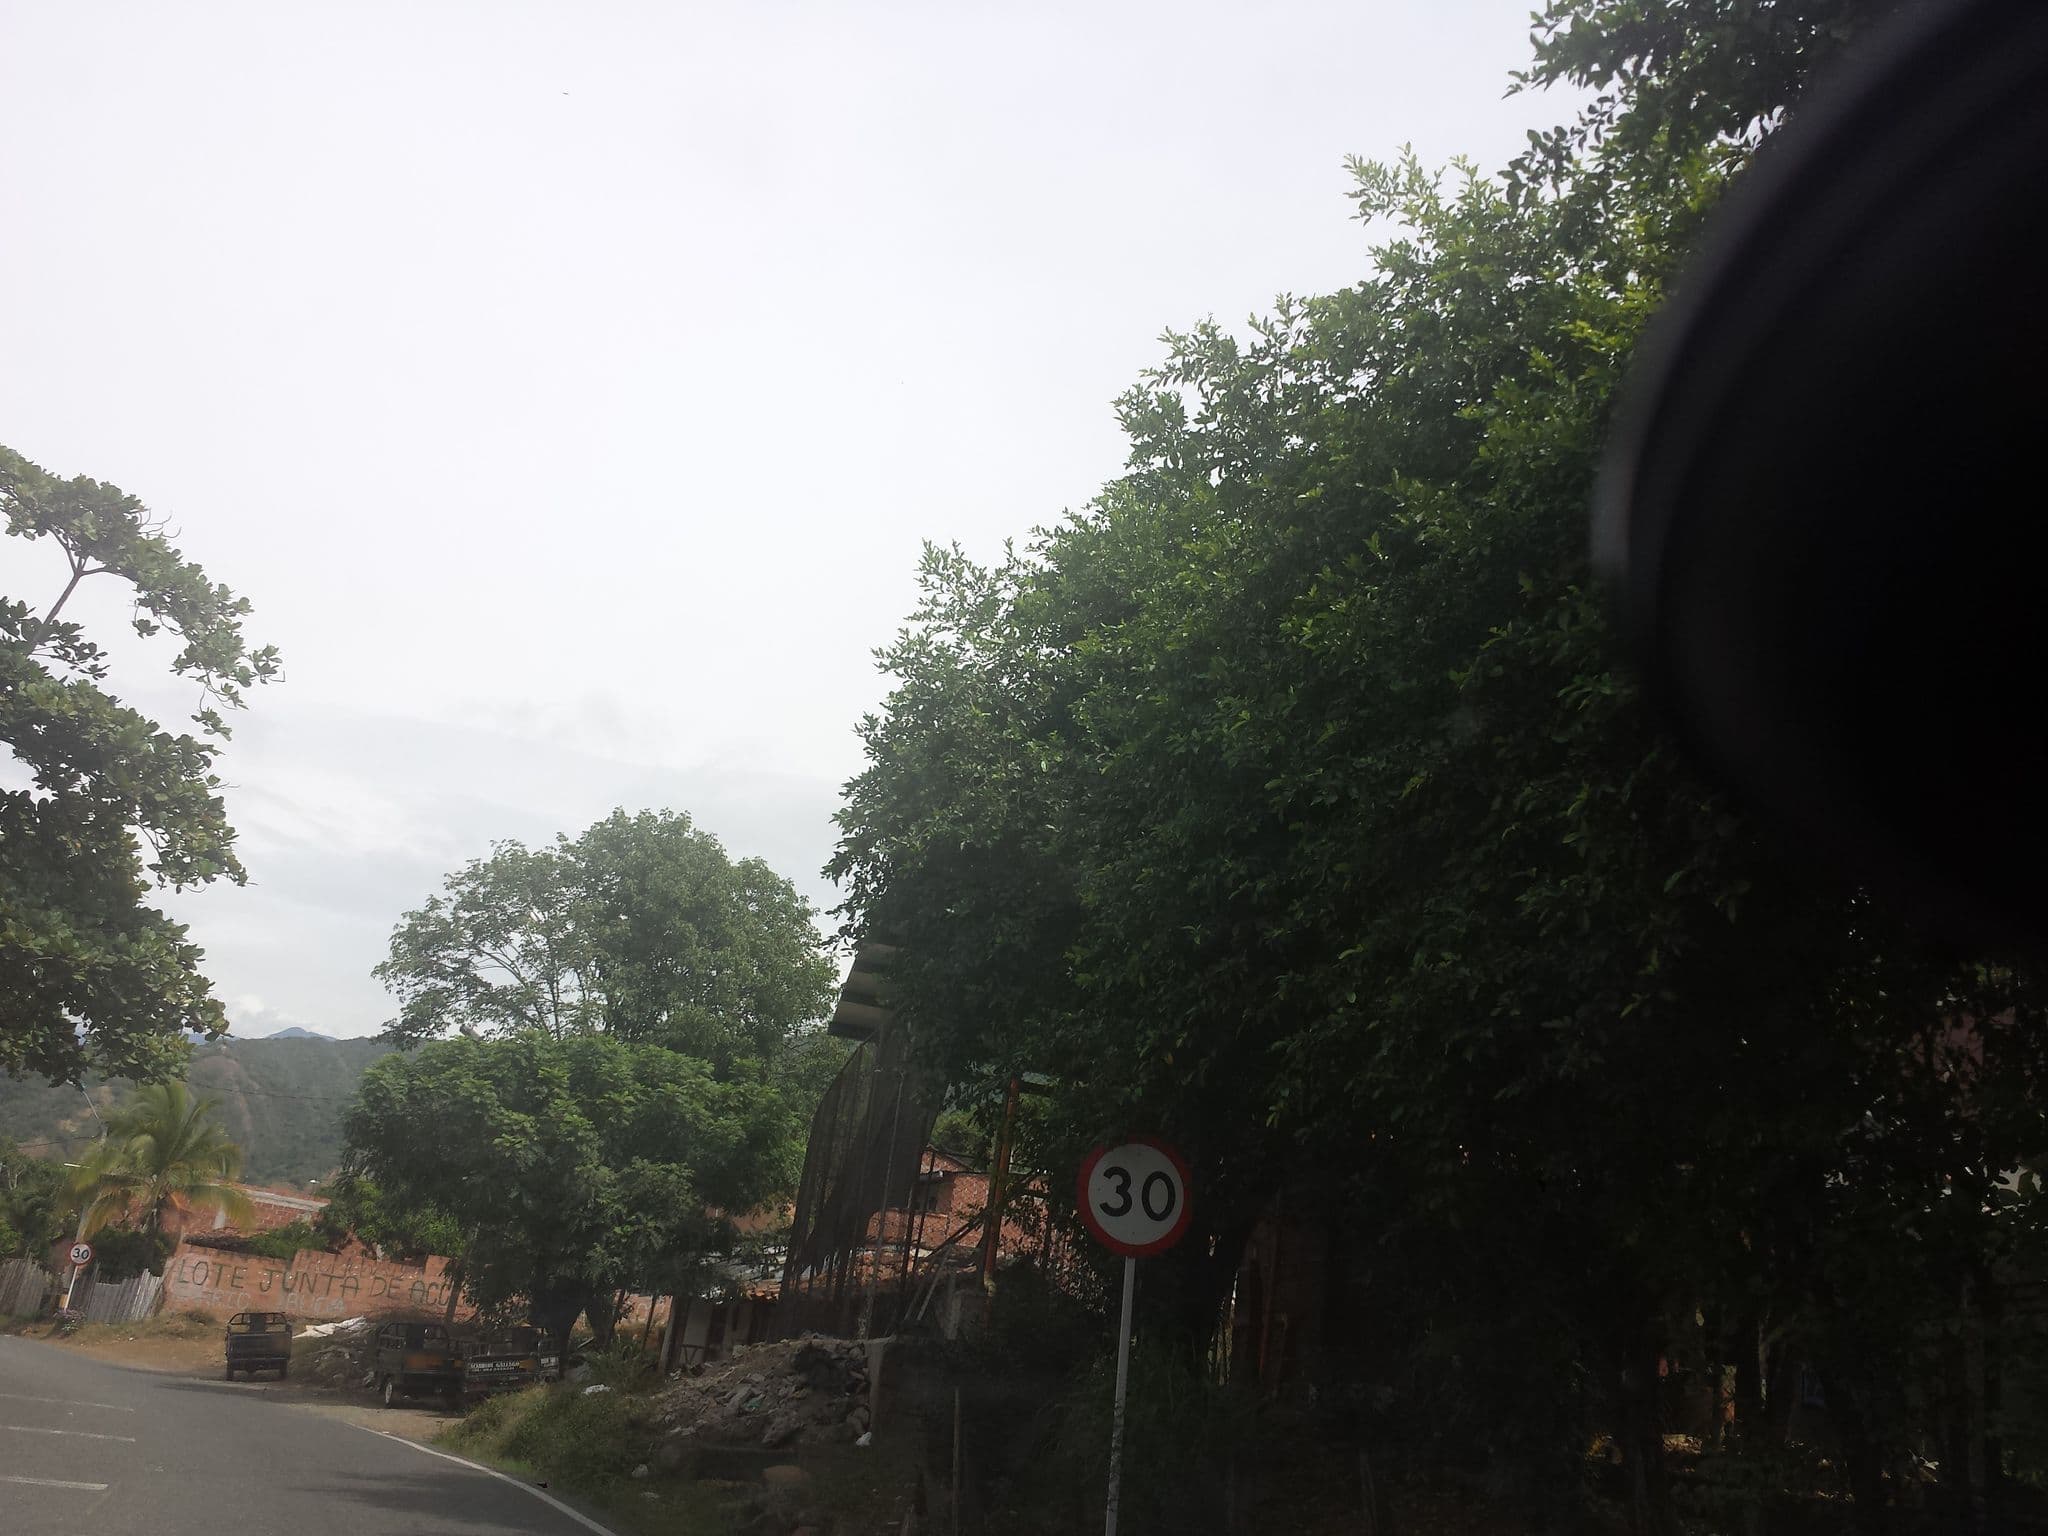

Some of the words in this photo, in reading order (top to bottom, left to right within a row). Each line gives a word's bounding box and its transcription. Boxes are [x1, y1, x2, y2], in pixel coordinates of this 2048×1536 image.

[1100, 1166, 1176, 1221] 30
[72, 1247, 90, 1260] 30
[177, 1258, 248, 1289] LOTE
[259, 1267, 360, 1299] JUNTA
[369, 1275, 404, 1299] DE
